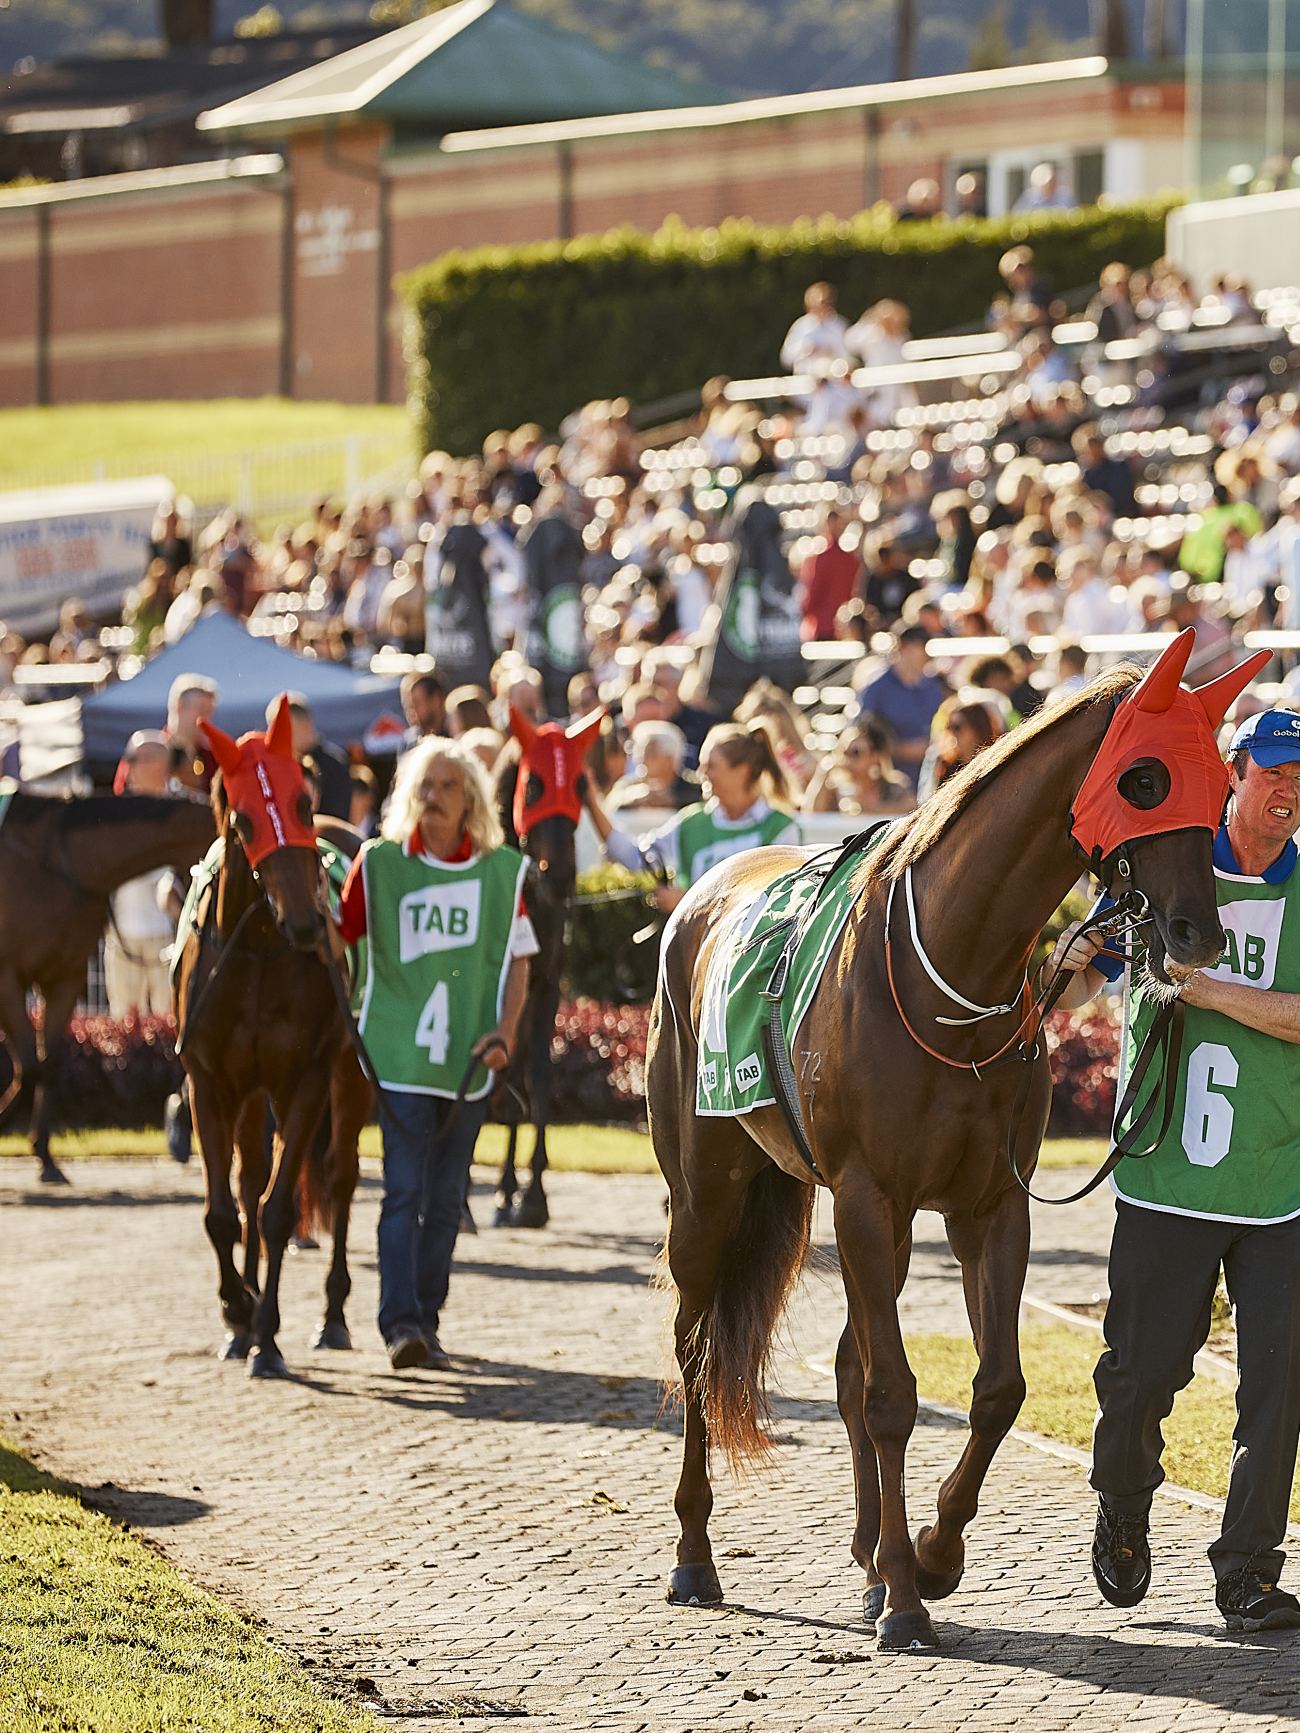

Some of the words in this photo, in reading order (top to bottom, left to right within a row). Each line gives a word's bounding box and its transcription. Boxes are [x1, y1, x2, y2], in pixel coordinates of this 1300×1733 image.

[407, 902, 469, 935] TAB
[1208, 928, 1266, 981] AB
[415, 980, 450, 1066] 4
[736, 1065, 760, 1082] TAB
[1181, 1041, 1239, 1168] 6
